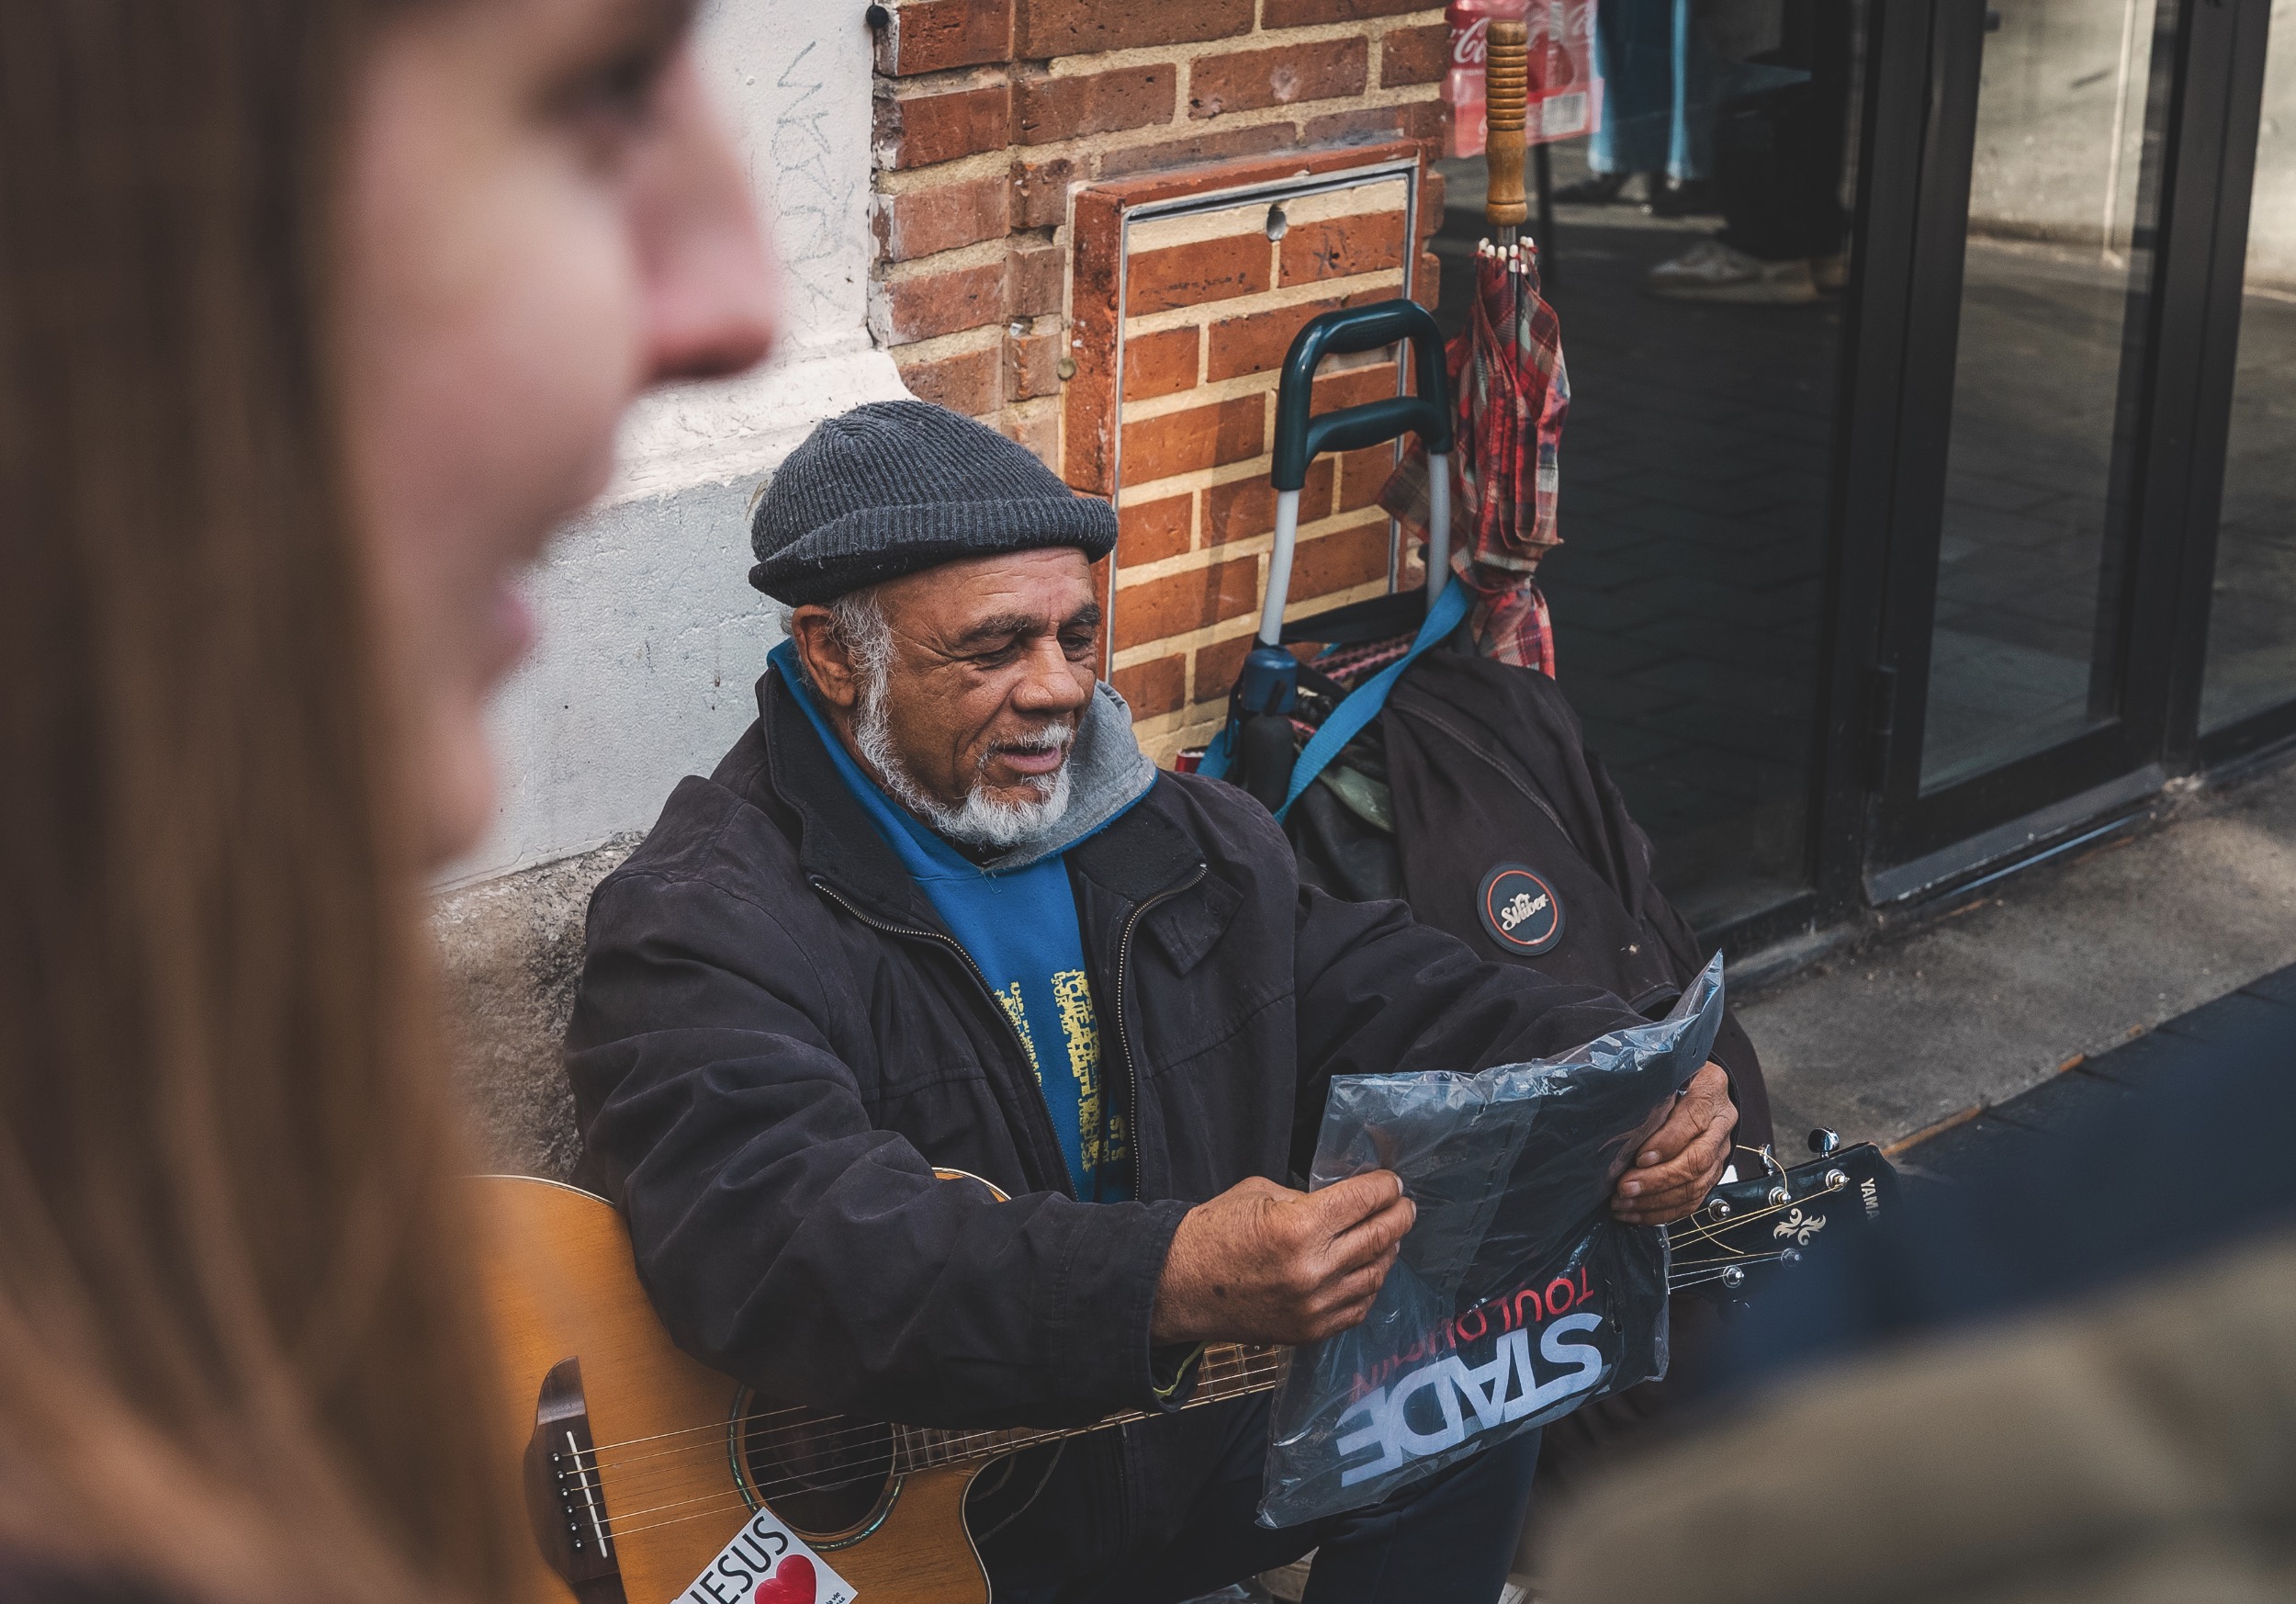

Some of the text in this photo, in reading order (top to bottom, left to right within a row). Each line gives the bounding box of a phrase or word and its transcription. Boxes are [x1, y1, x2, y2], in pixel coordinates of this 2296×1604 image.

[1860, 1177, 1881, 1220] YAMA
[1335, 1313, 1603, 1487] STADE
[690, 1516, 788, 1604] ESUS
